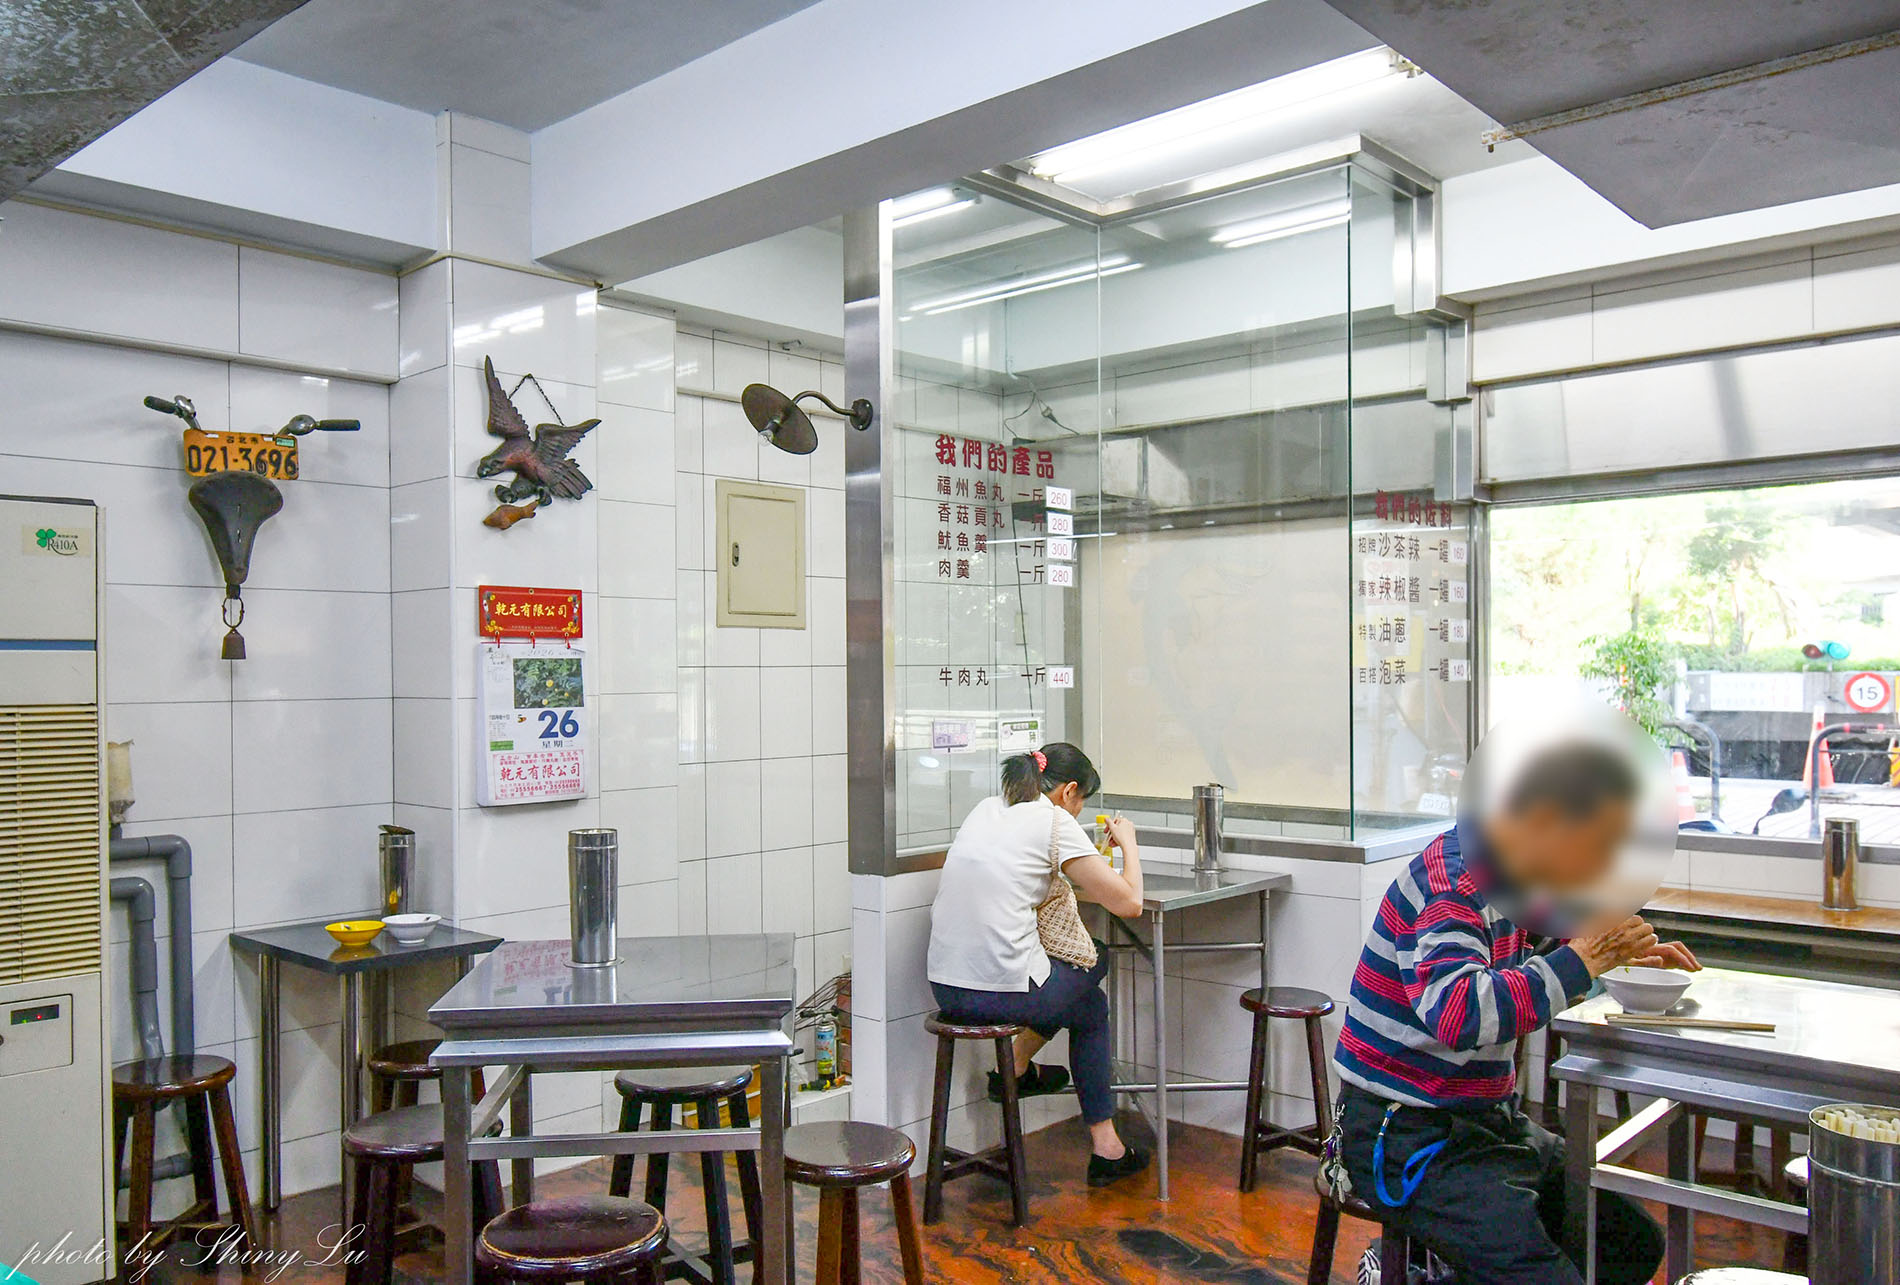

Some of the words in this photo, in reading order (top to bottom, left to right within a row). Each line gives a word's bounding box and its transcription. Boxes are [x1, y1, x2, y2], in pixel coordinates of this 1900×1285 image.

[187, 444, 297, 476] 021-3696
[935, 434, 1054, 479] 我們的產品
[937, 475, 1005, 502] 福州魚丸
[1017, 488, 1043, 504] 一斤
[1050, 491, 1068, 505] 260
[937, 502, 1005, 529] 香菇貢丸
[1051, 518, 1068, 531] 280
[47, 538, 78, 556] R410A
[937, 530, 988, 553] 魷魚羹
[1019, 540, 1045, 557] 一斤
[1051, 543, 1068, 556] 300
[938, 559, 970, 579] 肉羹
[1019, 565, 1045, 583] 一斤
[1052, 570, 1069, 582] 280
[494, 601, 567, 618] 乾元有限公司
[938, 666, 989, 687] 牛肉丸
[1020, 667, 1046, 685] 一斤
[1053, 672, 1070, 685] 440
[1856, 686, 1879, 700] 15
[538, 710, 579, 739] 26
[500, 762, 580, 781] 乾元有限公司
